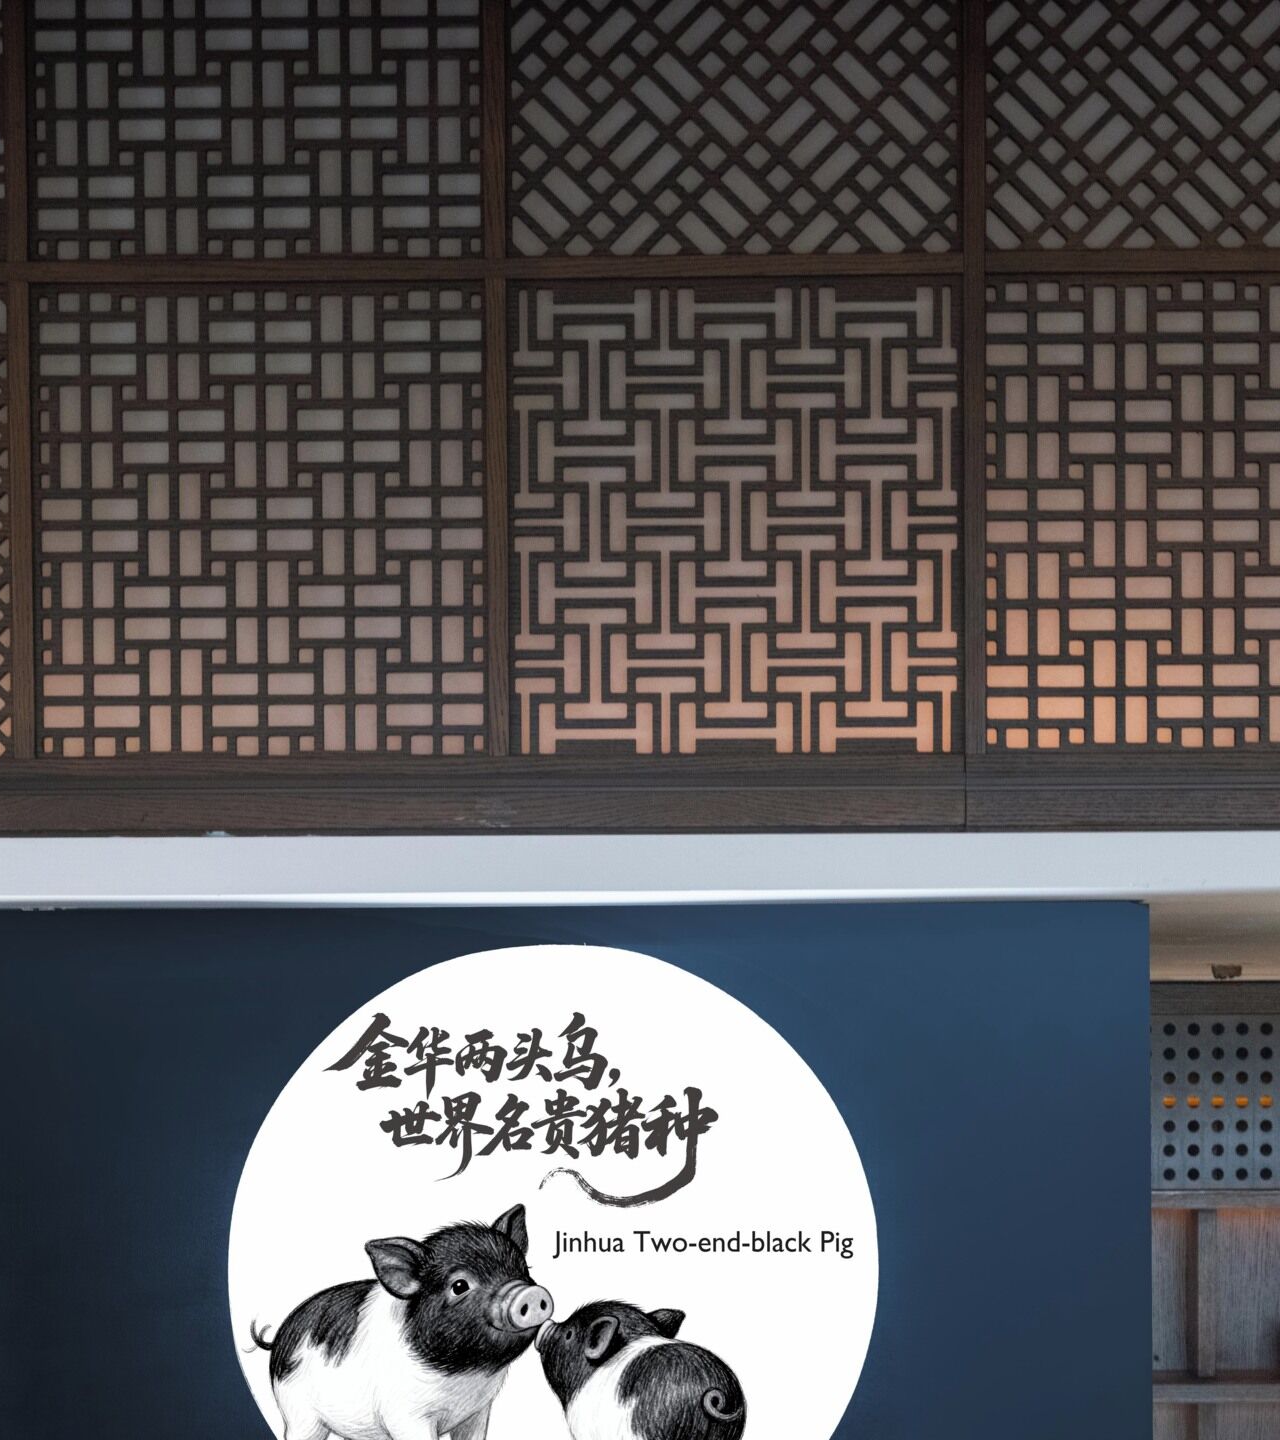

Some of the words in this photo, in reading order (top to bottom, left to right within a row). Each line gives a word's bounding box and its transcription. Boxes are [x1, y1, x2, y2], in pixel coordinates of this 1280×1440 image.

[379, 1086, 719, 1208] 世界名贵猪种
[552, 1230, 625, 1260] Jinhua
[633, 1230, 812, 1254] Two-end-black
[820, 1230, 854, 1260] Pig
